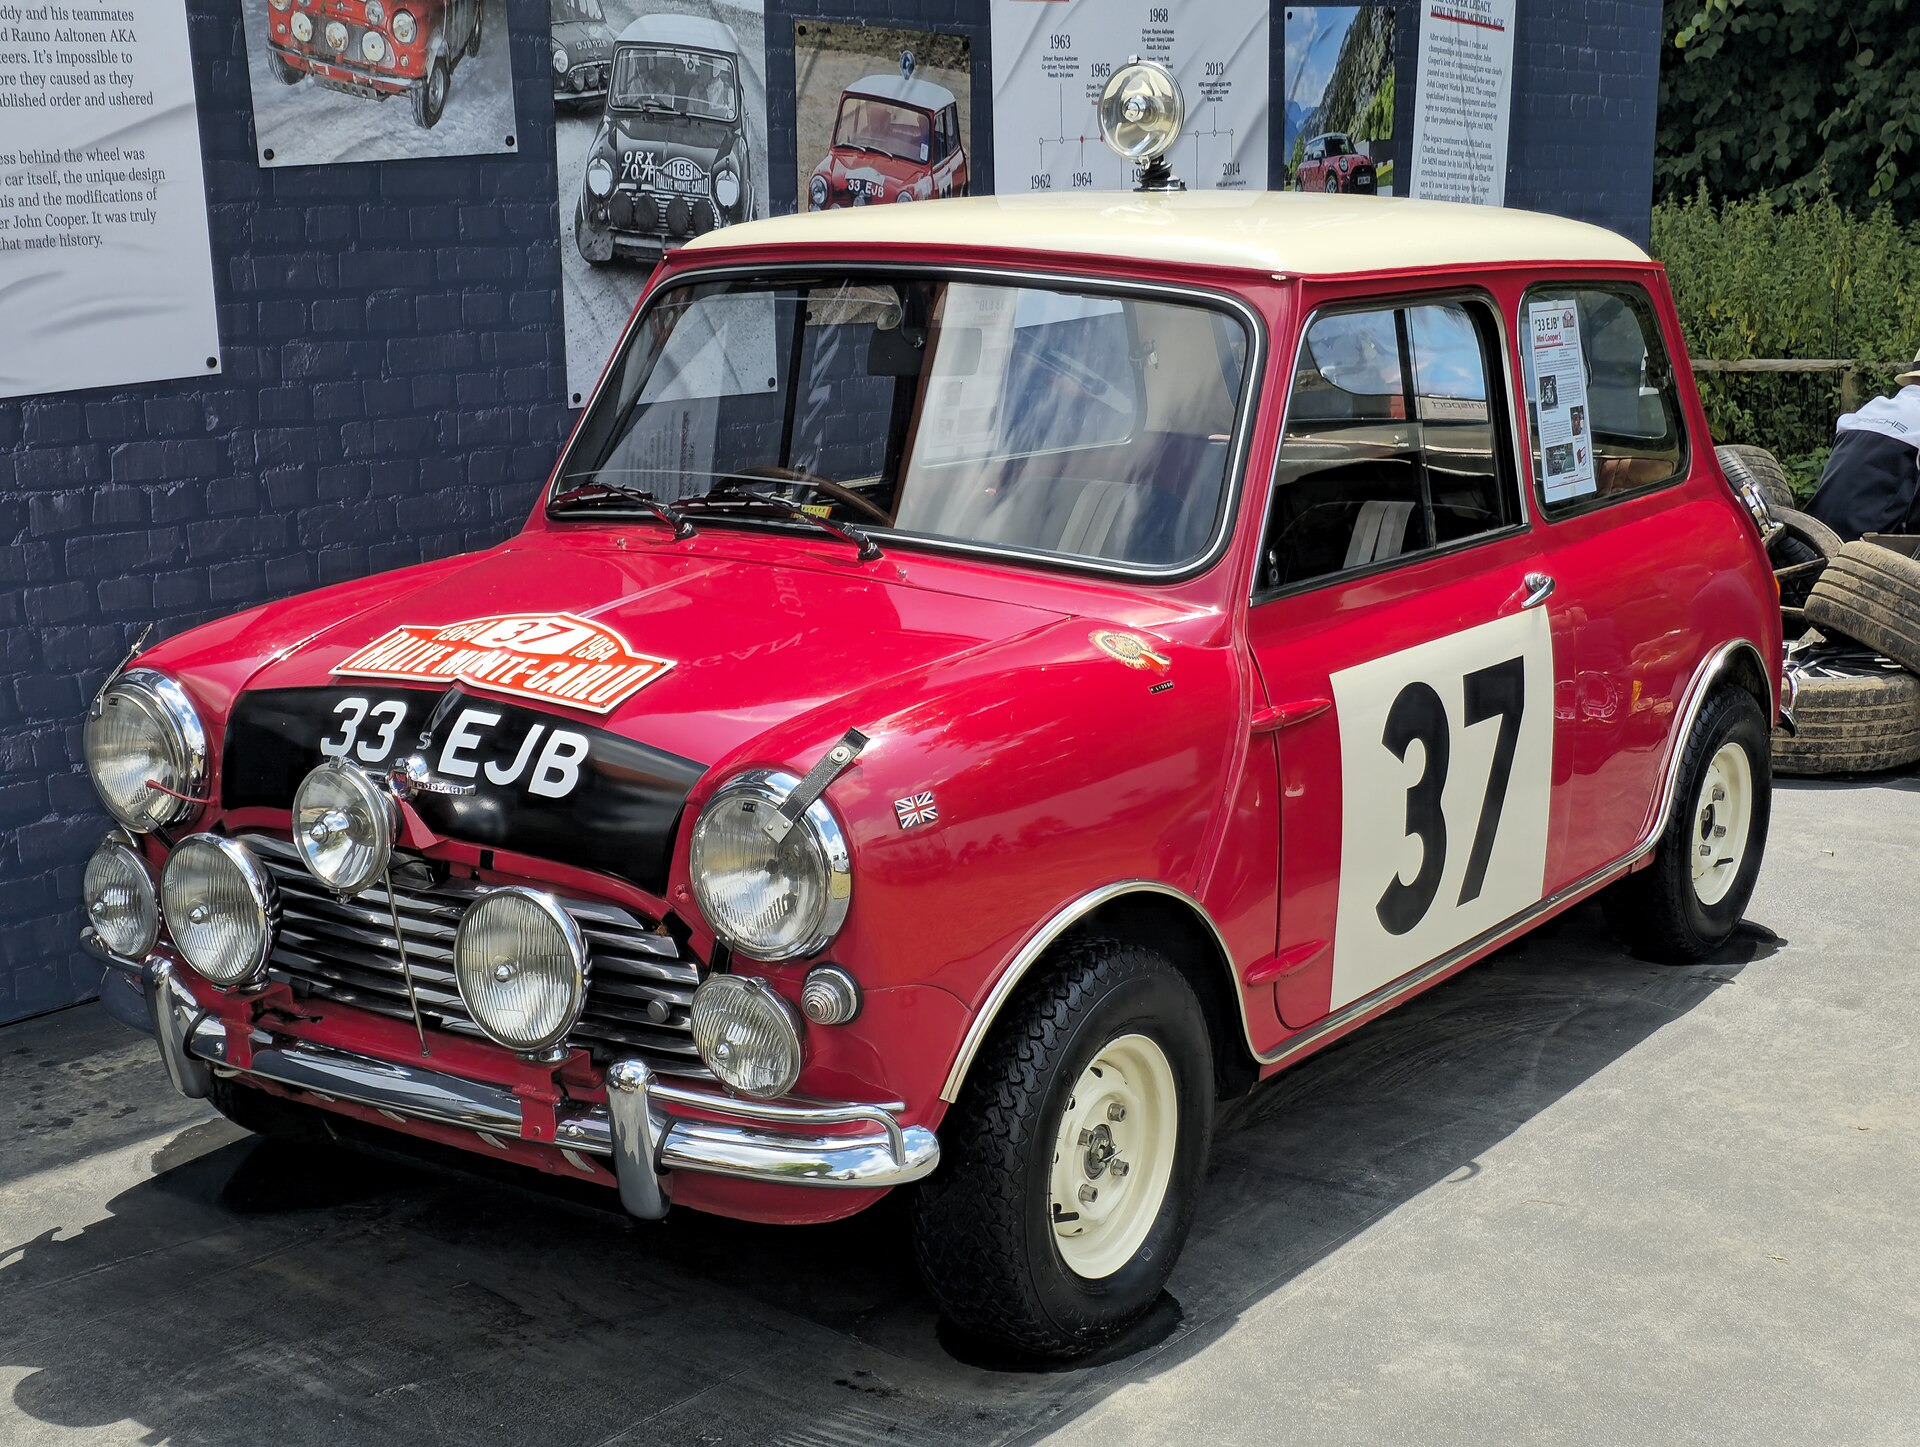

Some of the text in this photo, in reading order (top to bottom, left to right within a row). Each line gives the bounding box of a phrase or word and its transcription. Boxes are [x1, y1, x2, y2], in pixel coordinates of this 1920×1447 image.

[26, 6, 48, 20] and
[51, 6, 69, 21] his
[72, 8, 134, 22] teammates
[1150, 8, 1168, 23] 1968
[11, 28, 51, 42] Rauno
[54, 28, 107, 43] Aaltonen
[110, 29, 137, 43] AKA
[1050, 34, 1071, 49] 1963
[33, 49, 53, 64] It's
[56, 49, 118, 67] impossible
[121, 51, 133, 64] to
[1091, 62, 1111, 78] 1965
[1205, 62, 1224, 76] 2013
[19, 71, 46, 89] they
[50, 71, 90, 86] caused
[94, 75, 106, 85] as
[108, 71, 134, 88] they
[50, 92, 82, 107] order
[84, 92, 105, 106] and
[108, 91, 154, 105] ushered
[18, 149, 61, 165] behind
[64, 149, 83, 163] the
[86, 147, 120, 162] wheel
[122, 149, 145, 161] was
[4, 167, 166, 187] car itself, the unique design
[674, 163, 691, 177] 185
[1222, 162, 1241, 176] 2014
[656, 171, 673, 191] RALLYE
[848, 179, 884, 198] 33 EJB
[1030, 174, 1051, 190] 1962
[1072, 172, 1092, 187] 1964
[18, 192, 40, 208] and
[43, 192, 63, 206] the
[66, 189, 144, 205] modifications
[146, 187, 158, 201] of
[13, 214, 43, 229] John
[45, 213, 89, 229] Cooper.
[91, 211, 102, 224] It
[104, 212, 127, 223] was
[130, 208, 157, 224] truly
[24, 234, 56, 249] made
[58, 233, 103, 248] history.
[432, 621, 620, 662] 1964 37 1964
[348, 632, 649, 704] RALLYE MONTE-CARLO
[320, 697, 591, 799] 33 EJB
[416, 731, 432, 750] S
[1375, 655, 1525, 935] 37
